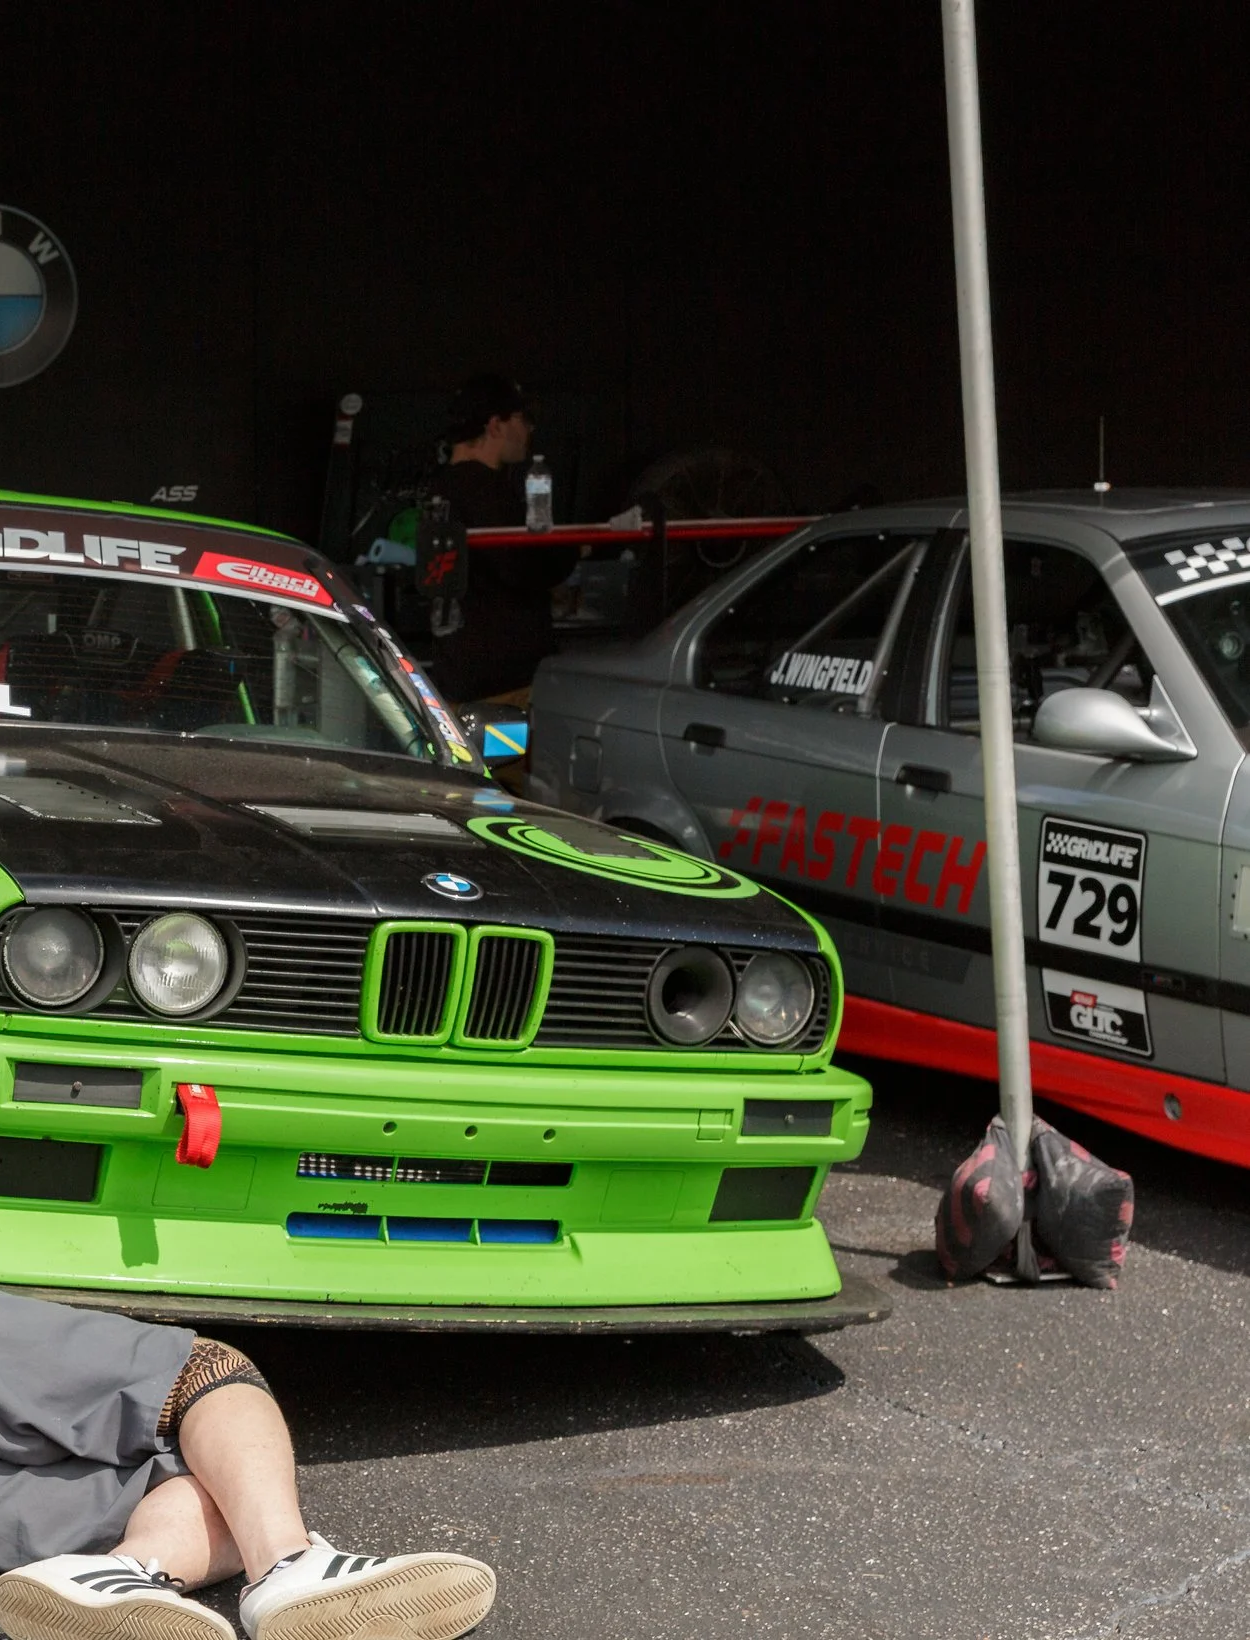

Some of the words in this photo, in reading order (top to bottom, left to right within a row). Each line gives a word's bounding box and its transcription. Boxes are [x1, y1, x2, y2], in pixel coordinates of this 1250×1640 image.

[770, 651, 873, 695] J.WINGFIELD
[752, 801, 988, 915] FASTECH
[1067, 836, 1139, 869] GRIDLIFE
[1045, 870, 1138, 946] 729
[1070, 1004, 1123, 1035] GLTC
